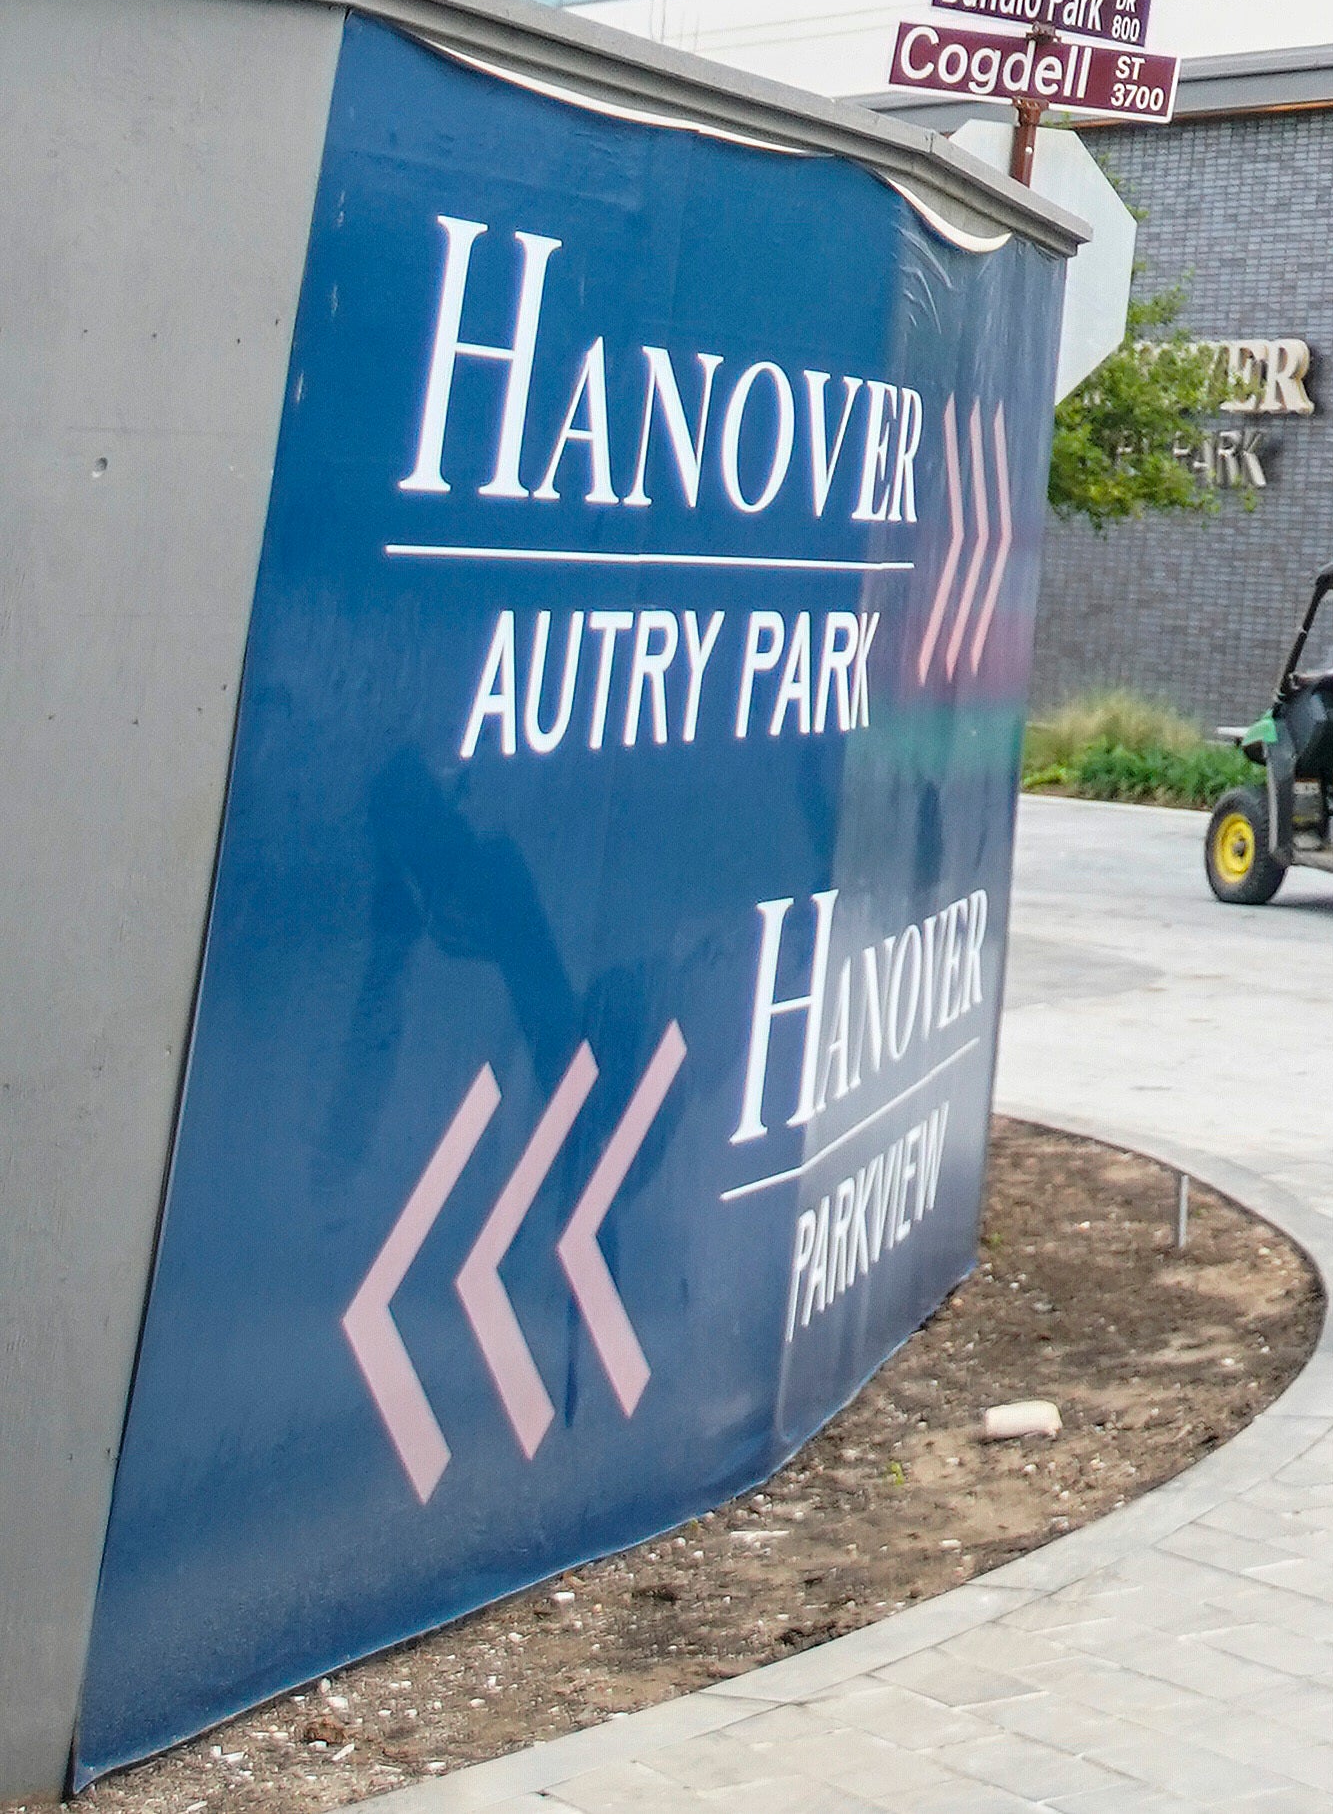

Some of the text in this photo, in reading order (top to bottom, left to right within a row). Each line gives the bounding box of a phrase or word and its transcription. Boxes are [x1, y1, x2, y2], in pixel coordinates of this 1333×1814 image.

[900, 26, 1093, 99] Cogdell
[1111, 14, 1140, 42] 800
[1115, 55, 1145, 80] ST
[1110, 83, 1165, 112] 3700
[399, 214, 924, 524] HANOVER
[459, 610, 881, 759] AUTRY PARK
[729, 888, 989, 1146] HANOVER
[784, 1100, 950, 1344] PARKVIEW
